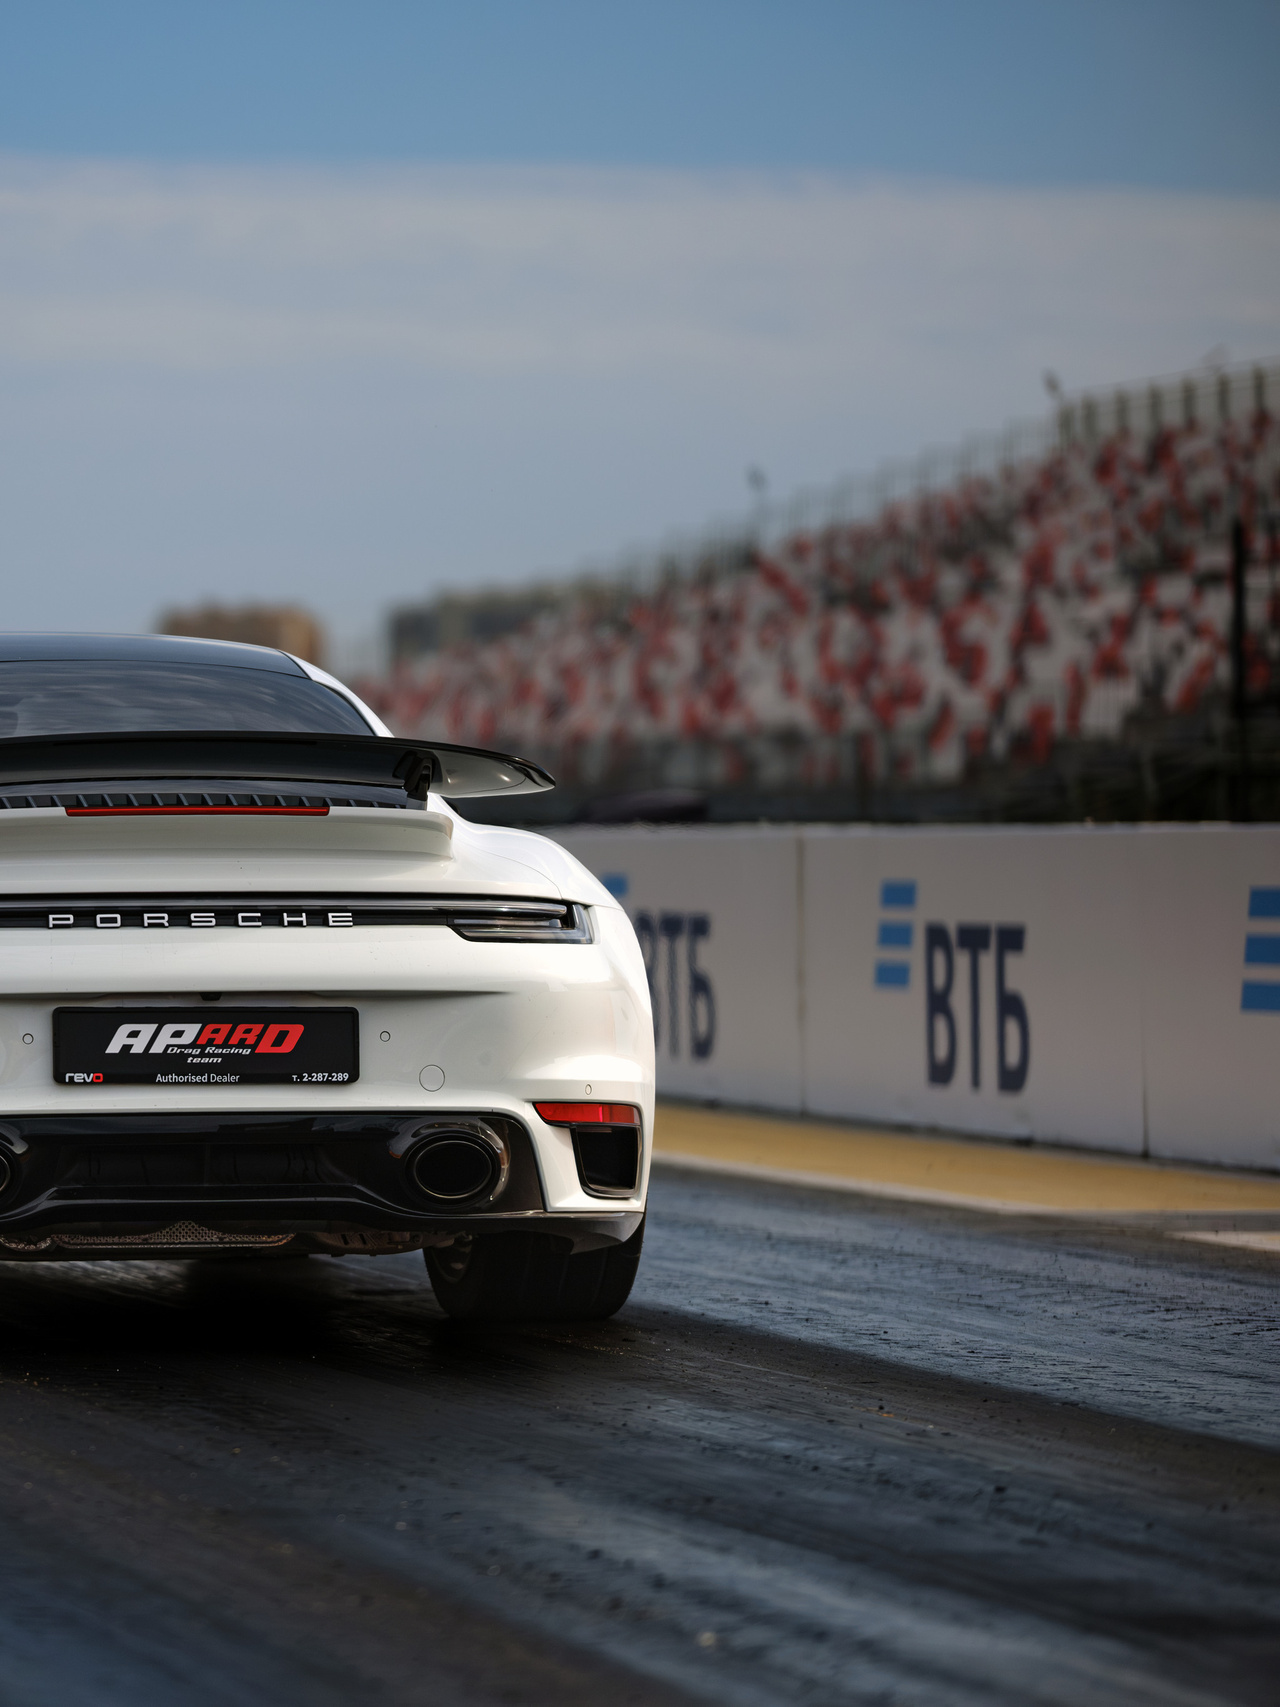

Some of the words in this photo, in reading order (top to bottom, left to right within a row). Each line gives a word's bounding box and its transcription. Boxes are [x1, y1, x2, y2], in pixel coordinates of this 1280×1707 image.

[48, 913, 354, 928] PORSCHE
[924, 922, 1031, 1094] ВТБ
[105, 1023, 305, 1054] APARD
[166, 1046, 201, 1055] Drag
[204, 1046, 251, 1055] Racing
[65, 1072, 103, 1083] revo
[155, 1073, 208, 1083] Authorised
[210, 1073, 240, 1083] Dealer
[302, 1072, 349, 1082] 2-287-289
